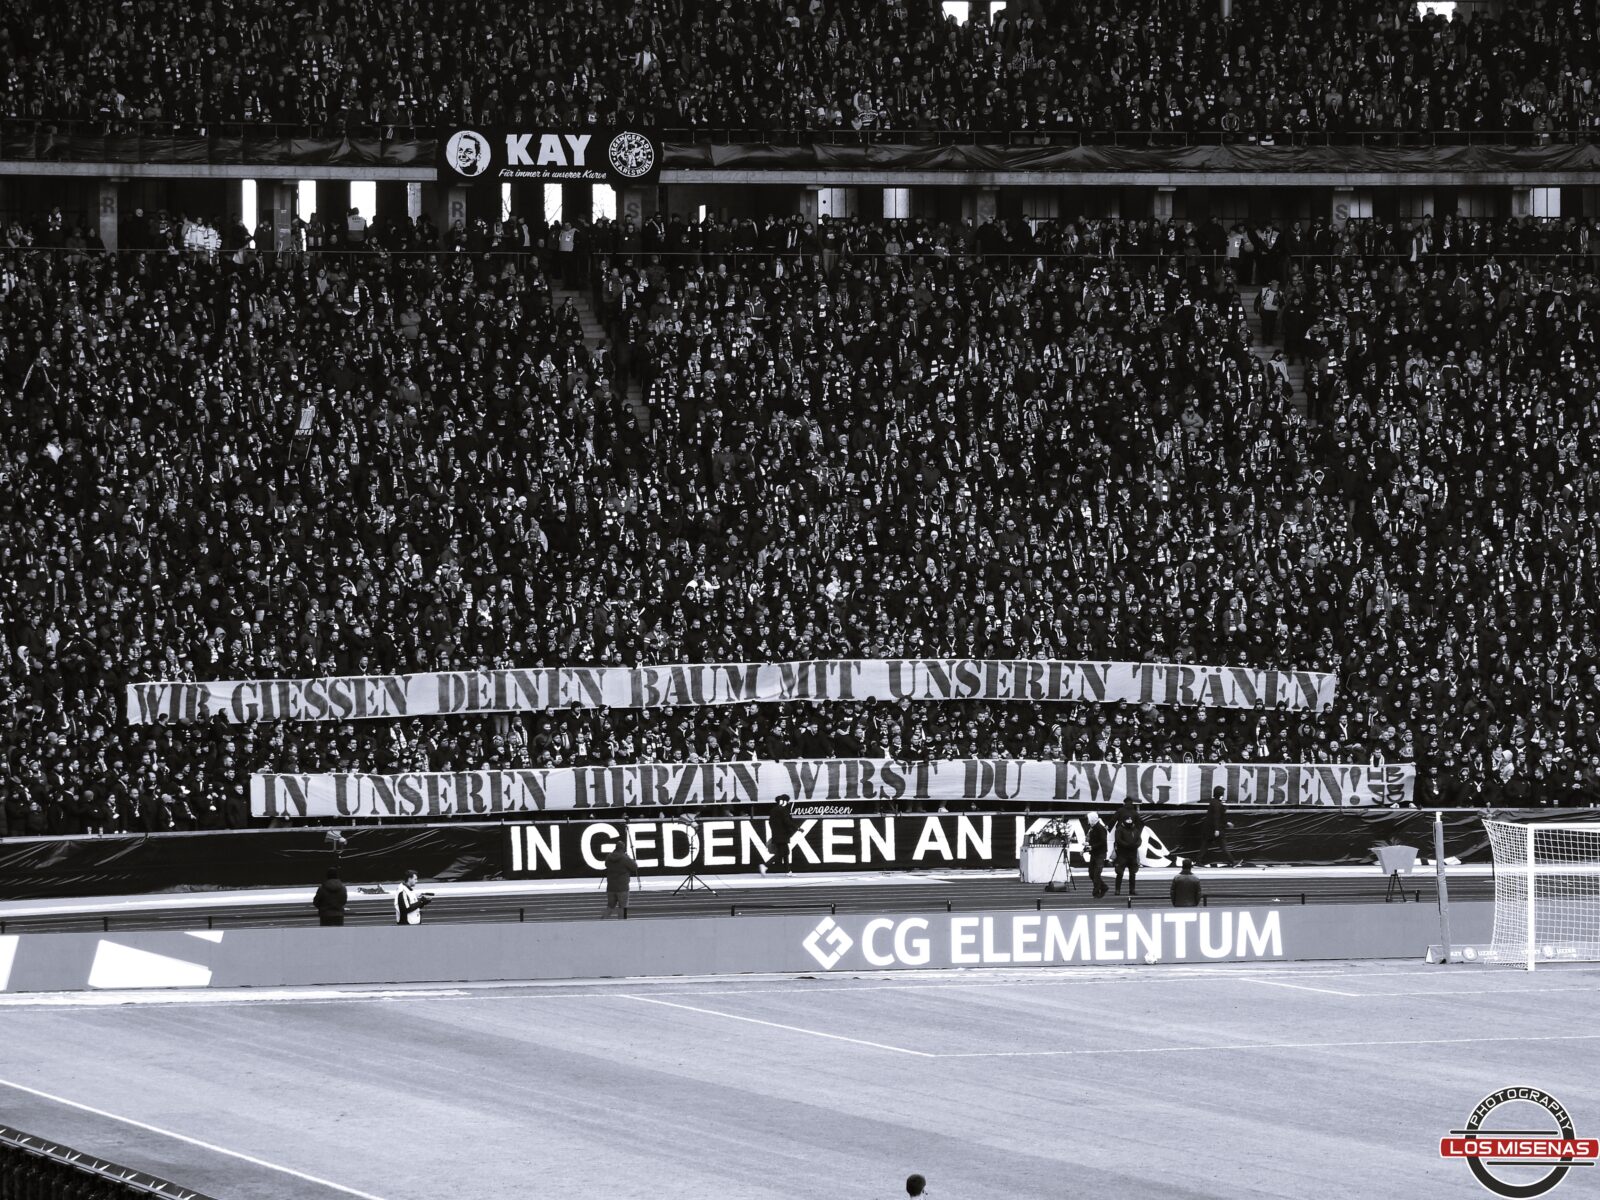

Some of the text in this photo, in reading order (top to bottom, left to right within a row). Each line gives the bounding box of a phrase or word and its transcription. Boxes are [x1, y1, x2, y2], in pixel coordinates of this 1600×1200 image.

[505, 133, 592, 166] KAY
[498, 168, 607, 179] Für immer in unserer Kurve
[451, 201, 465, 217] R
[626, 202, 641, 219] S
[1335, 203, 1349, 220] S
[134, 660, 1328, 724] WIR GIESSEN DEINEN BAUM MIT UNSEREN TRÄNEN
[261, 759, 1362, 817] IN UNSEREN HERZEN WIRST DU EWIG LEBEN!
[510, 824, 562, 871] IN
[580, 816, 896, 871] GEDENKEN
[912, 816, 993, 861] AN
[861, 910, 1284, 966] CG ELEMENTUM
